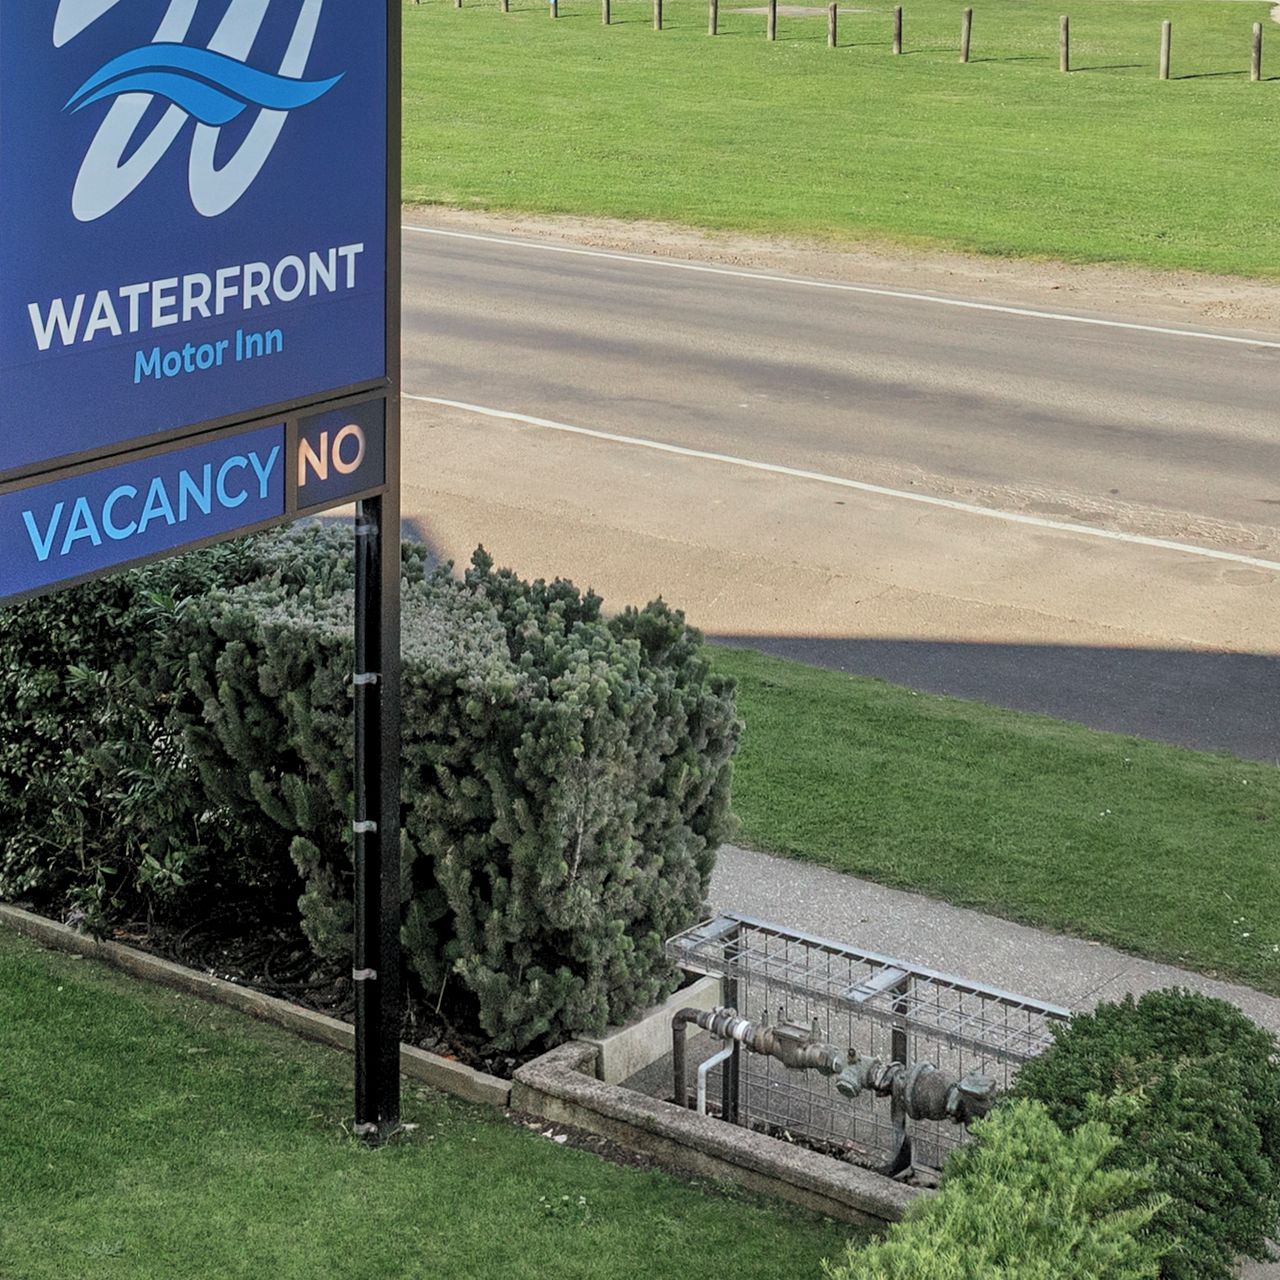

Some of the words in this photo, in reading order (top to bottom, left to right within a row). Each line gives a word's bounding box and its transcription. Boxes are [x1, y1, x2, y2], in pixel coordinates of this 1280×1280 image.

[27, 242, 364, 351] WATERFRONT
[133, 339, 229, 384] Motor
[236, 328, 283, 361] Inn
[21, 445, 281, 562] VACANCY
[297, 423, 366, 487] NO
